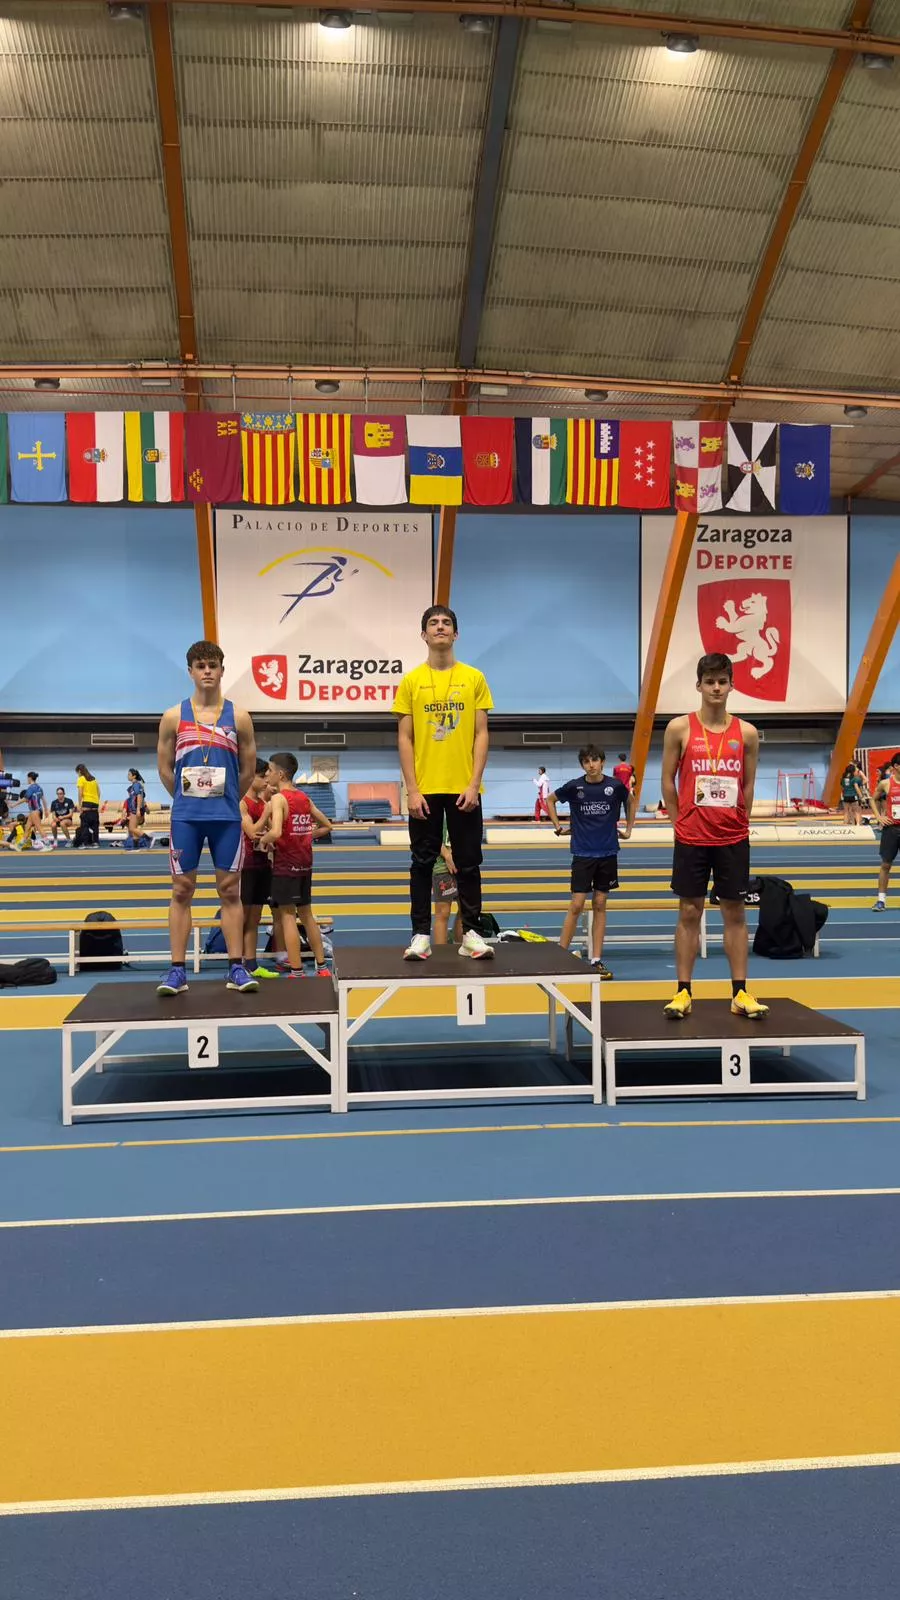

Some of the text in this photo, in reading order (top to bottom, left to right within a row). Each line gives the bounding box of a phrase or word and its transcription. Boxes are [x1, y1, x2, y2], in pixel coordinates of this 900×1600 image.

[232, 514, 419, 533] PALACIO DE DEPORTES
[696, 524, 792, 548] Zaragoza
[696, 549, 792, 570] DEPORTE
[298, 655, 403, 681] Zaragoza
[424, 702, 465, 713] SCORPIO
[291, 814, 311, 825] ZGZ
[466, 993, 473, 1015] 1
[197, 1036, 210, 1059] 2
[729, 1055, 741, 1077] 3
